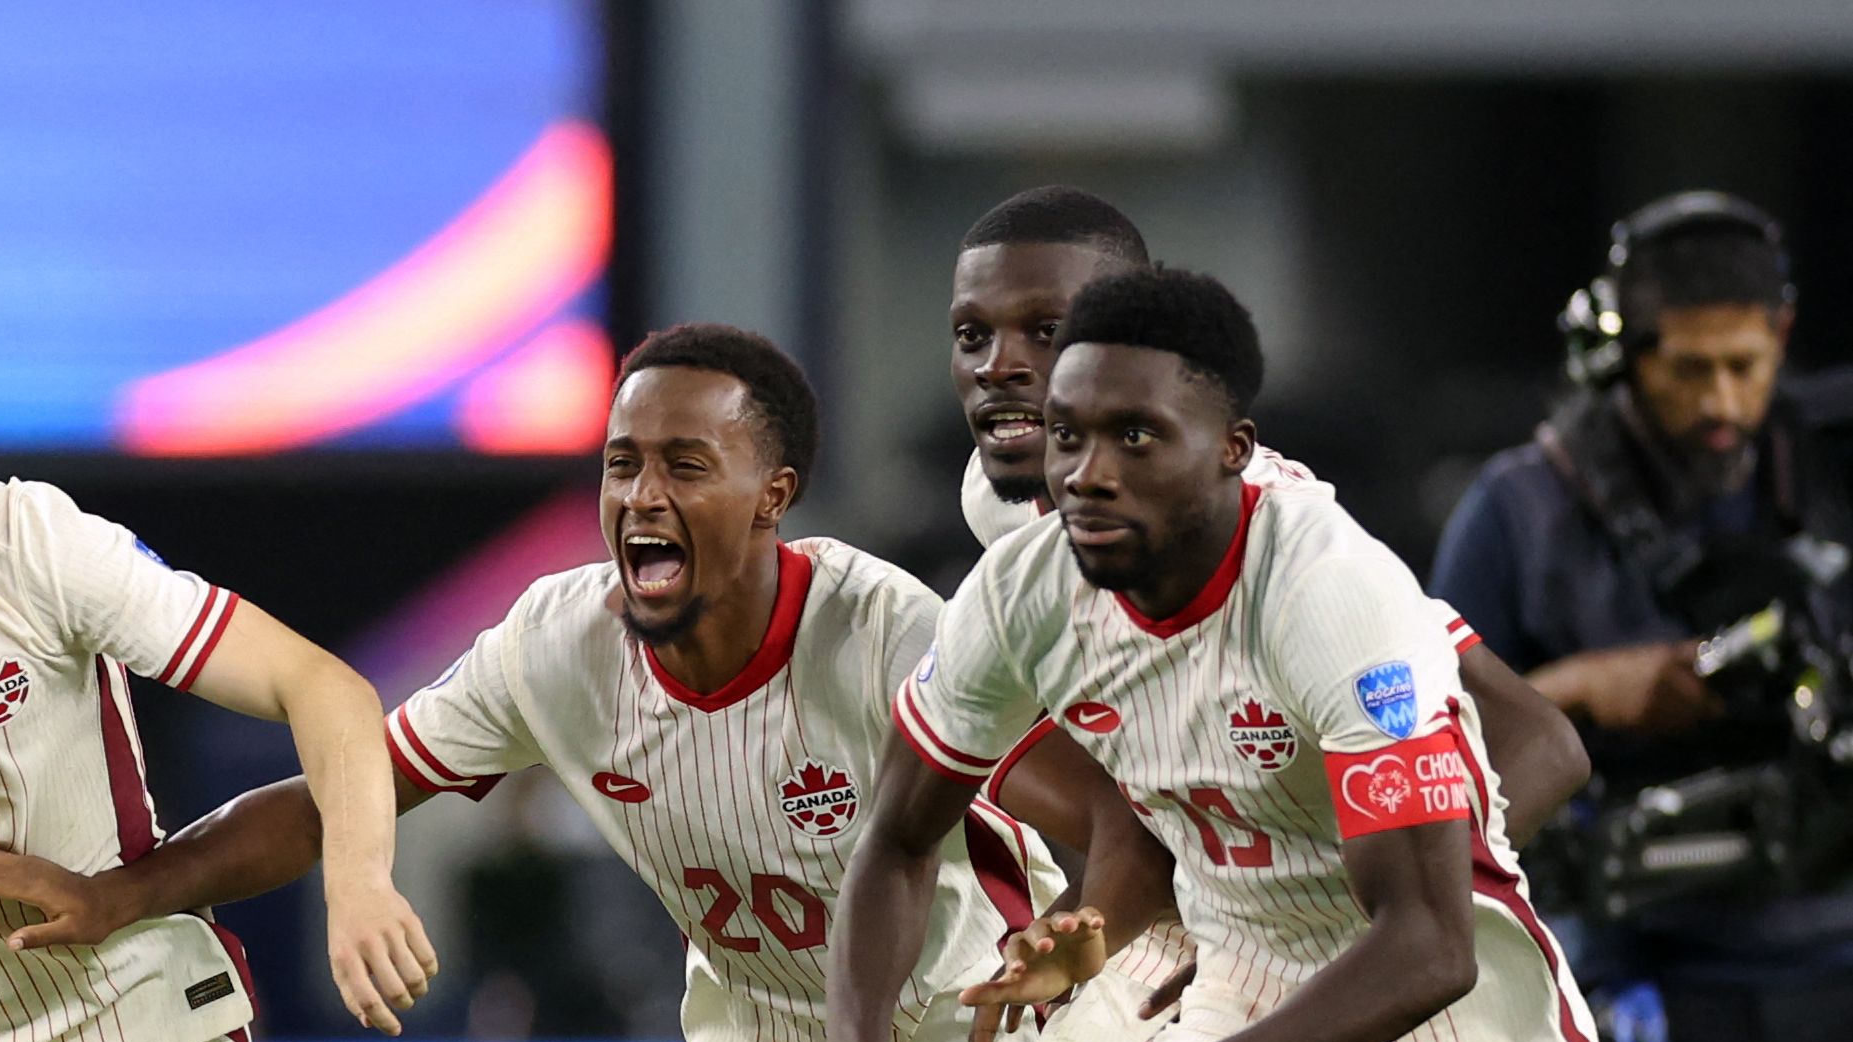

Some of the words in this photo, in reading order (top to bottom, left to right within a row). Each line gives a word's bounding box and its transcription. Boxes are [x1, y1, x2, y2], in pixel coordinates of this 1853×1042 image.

[1229, 729, 1295, 742] CANADA
[782, 788, 856, 813] CANADA
[1419, 784, 1449, 813] TO
[683, 867, 827, 952] 20
